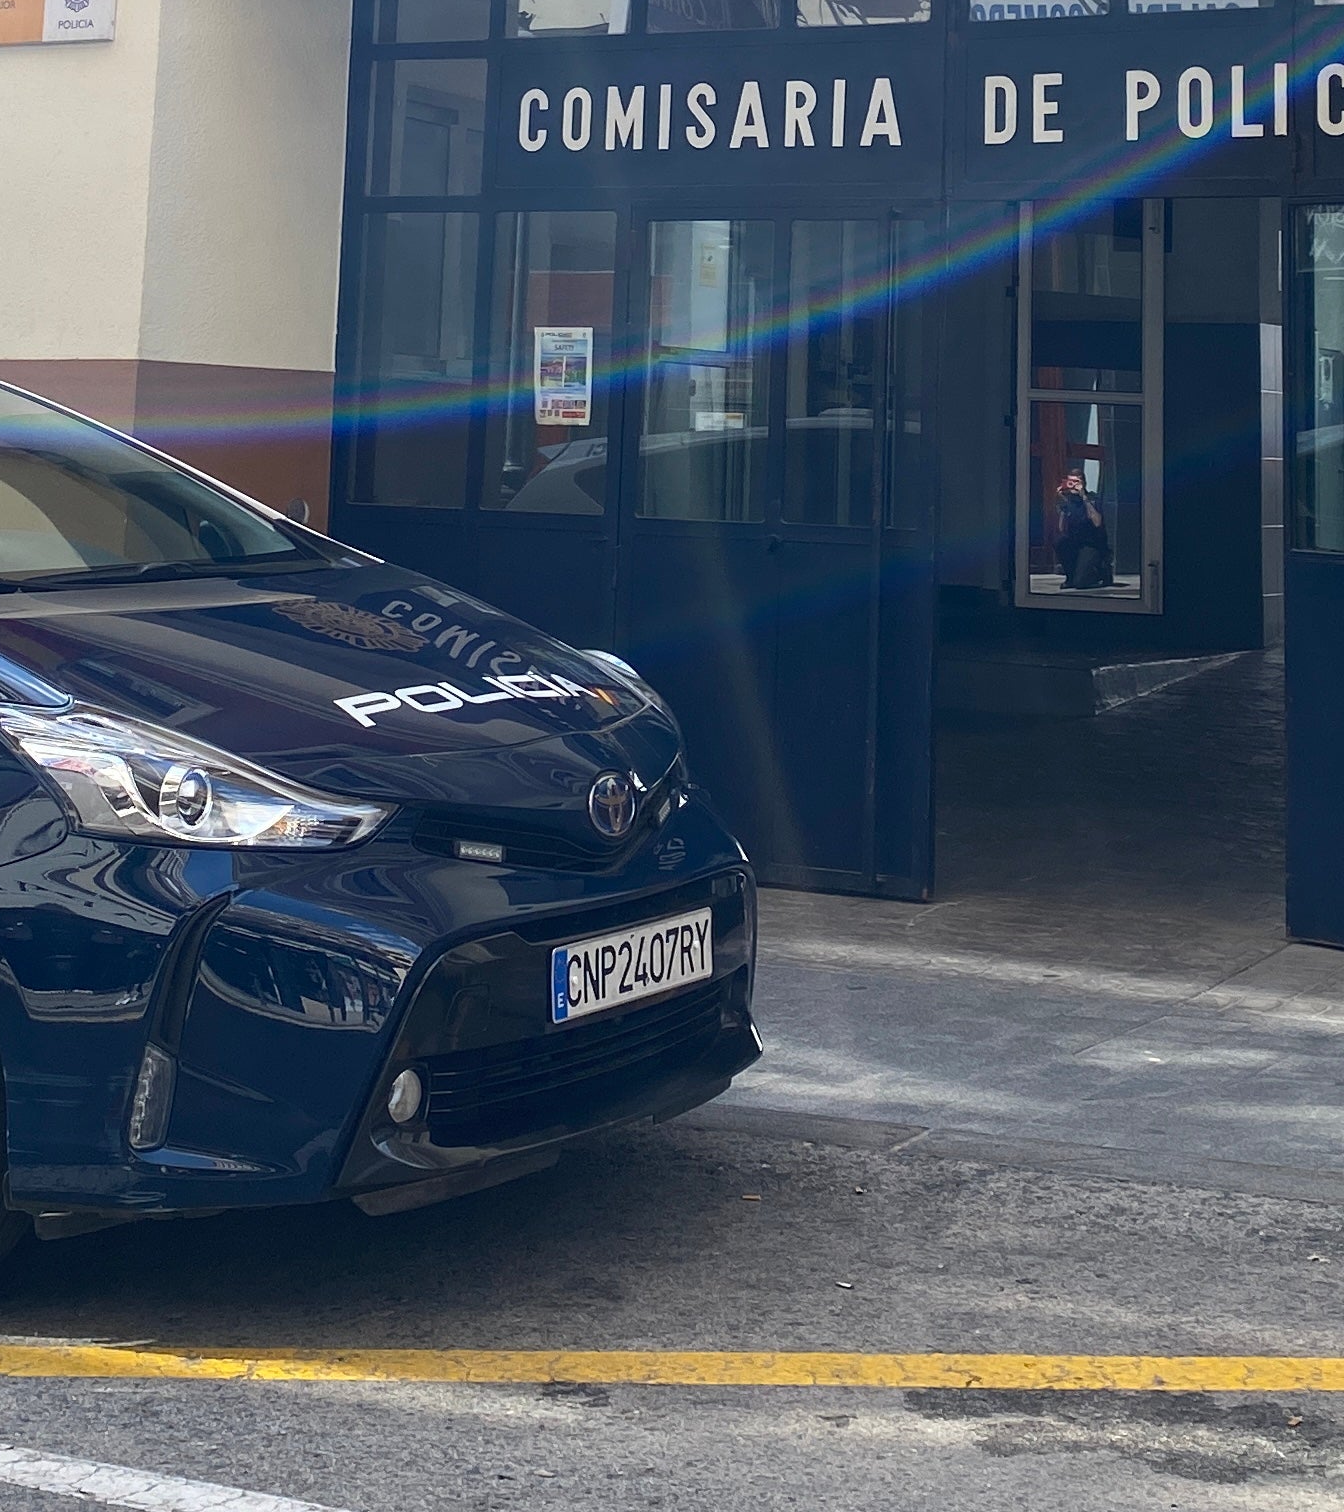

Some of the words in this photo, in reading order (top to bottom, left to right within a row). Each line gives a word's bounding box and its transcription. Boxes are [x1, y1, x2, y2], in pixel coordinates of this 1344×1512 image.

[58, 19, 94, 29] POLICIA
[519, 77, 903, 152] COMISARIA
[984, 73, 1063, 145] DE
[567, 919, 709, 1007] CNP2407RY
